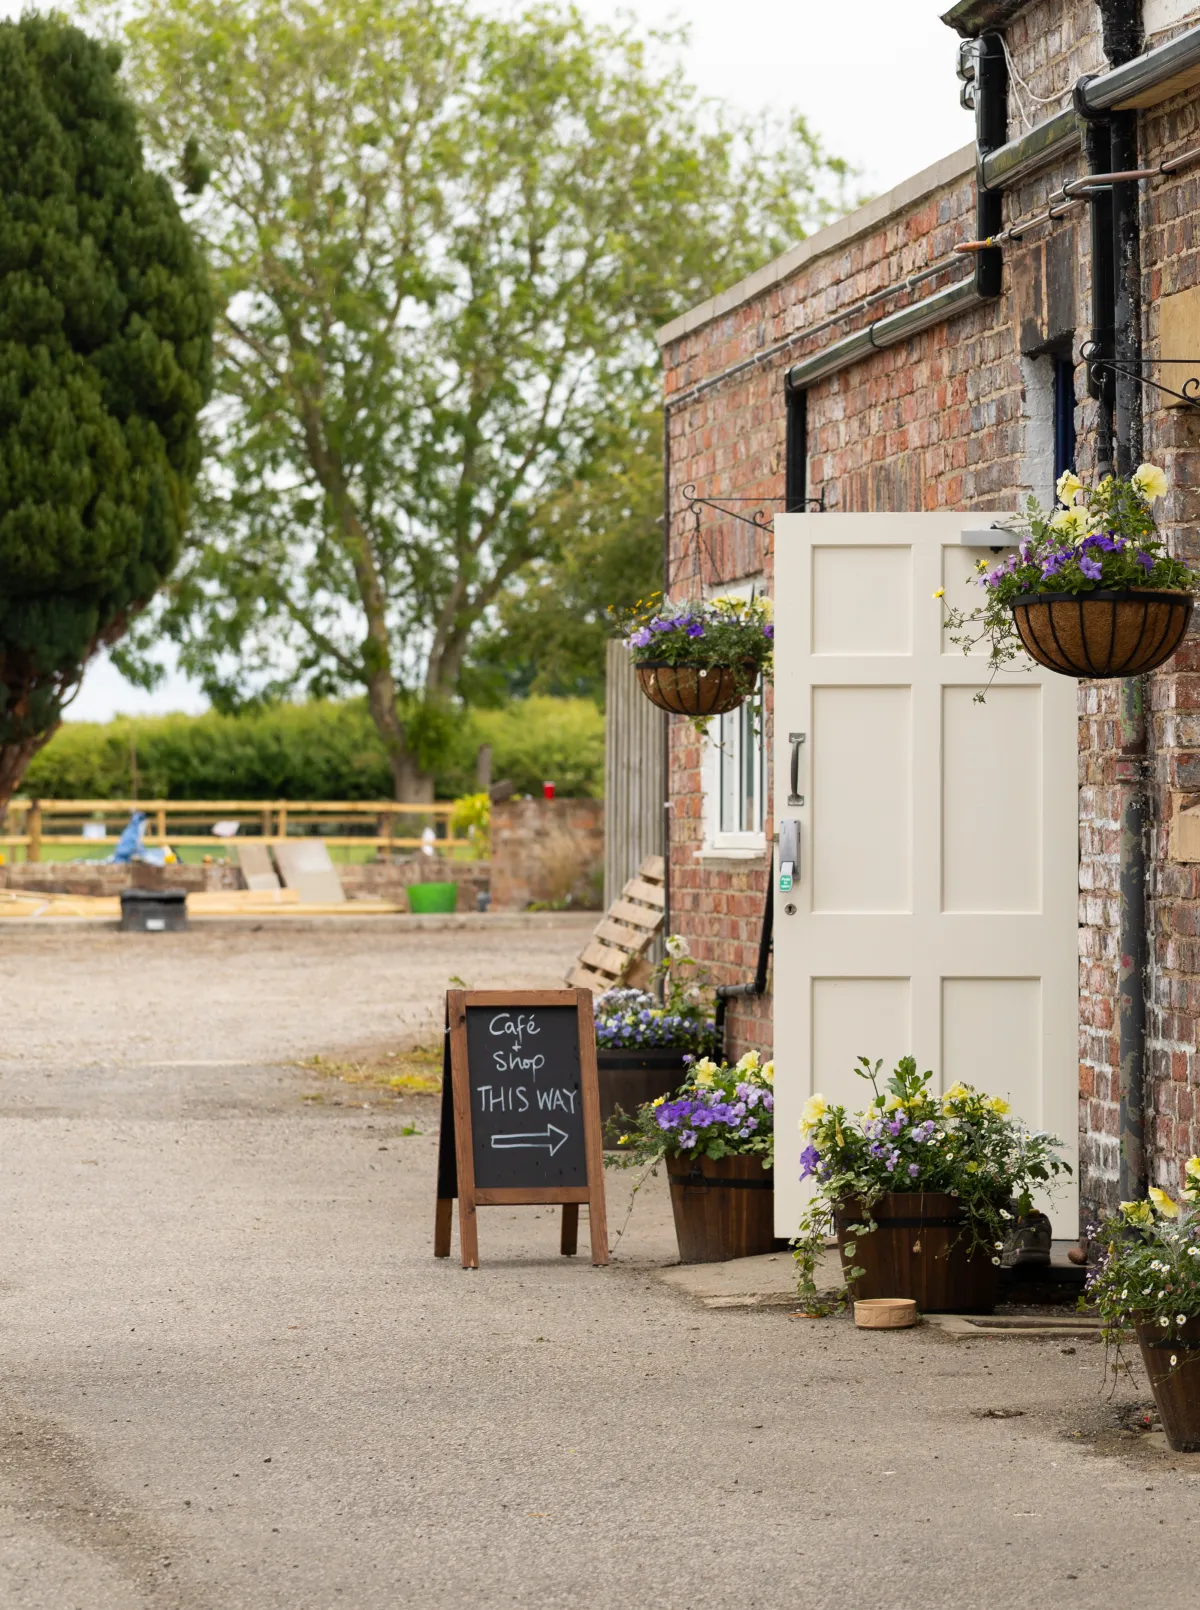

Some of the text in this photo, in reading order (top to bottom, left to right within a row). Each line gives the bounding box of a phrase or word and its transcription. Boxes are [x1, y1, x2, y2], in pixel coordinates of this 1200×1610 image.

[489, 1013, 541, 1043] Café
[512, 1040, 521, 1052] +
[493, 1051, 545, 1083] Shop
[477, 1085, 577, 1114] THIS WAY
